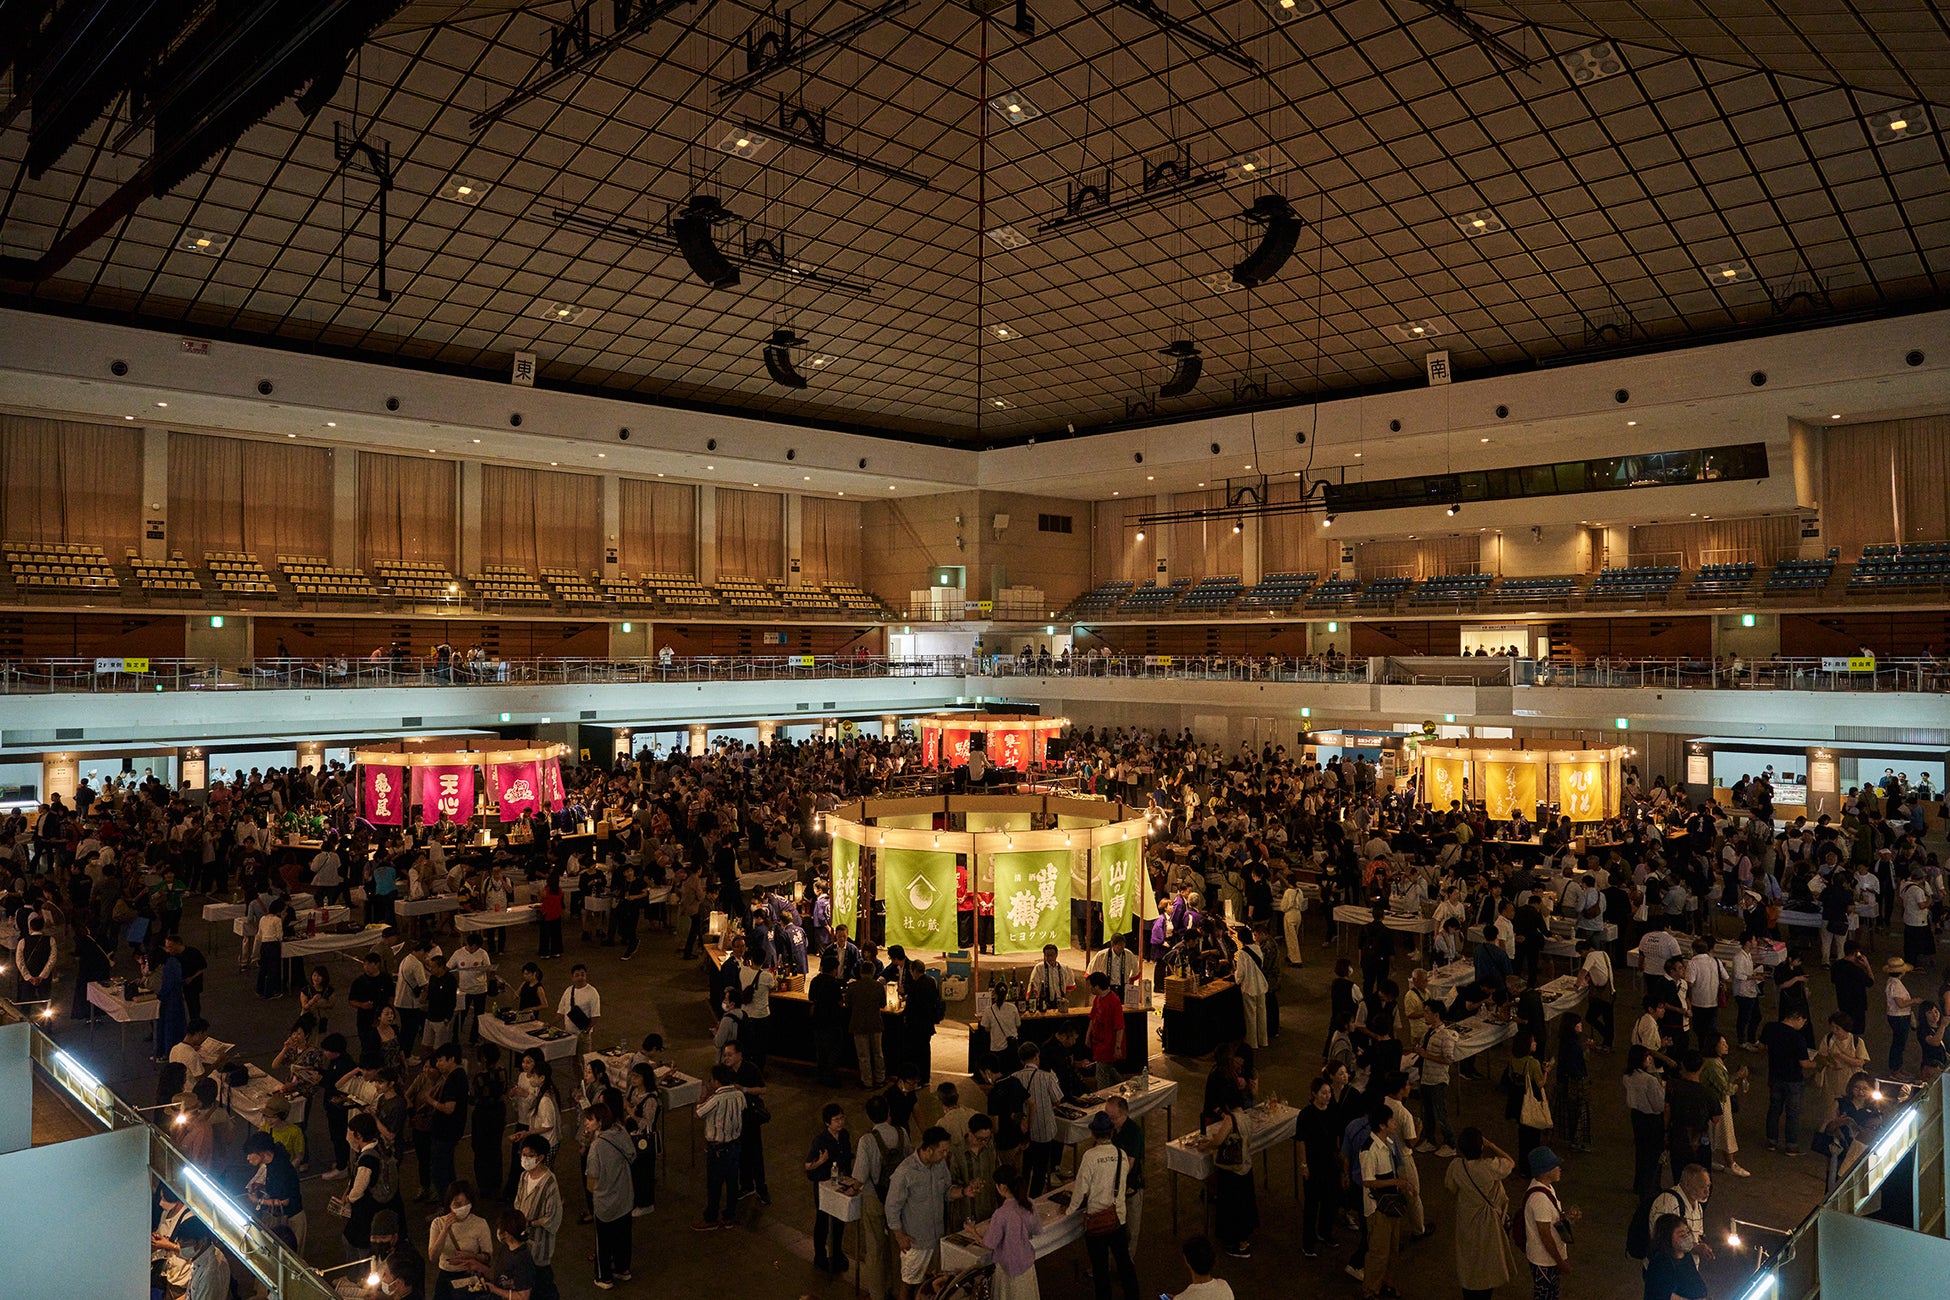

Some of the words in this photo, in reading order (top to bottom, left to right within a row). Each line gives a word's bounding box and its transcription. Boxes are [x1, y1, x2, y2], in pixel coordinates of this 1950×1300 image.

[515, 359, 533, 381] 東
[1430, 359, 1447, 380] 南
[1004, 733, 1021, 767] 寒北斗
[437, 774, 460, 815] 天心
[903, 916, 940, 932] 杜の蔵
[1009, 932, 1058, 942] ヒヨクツル
